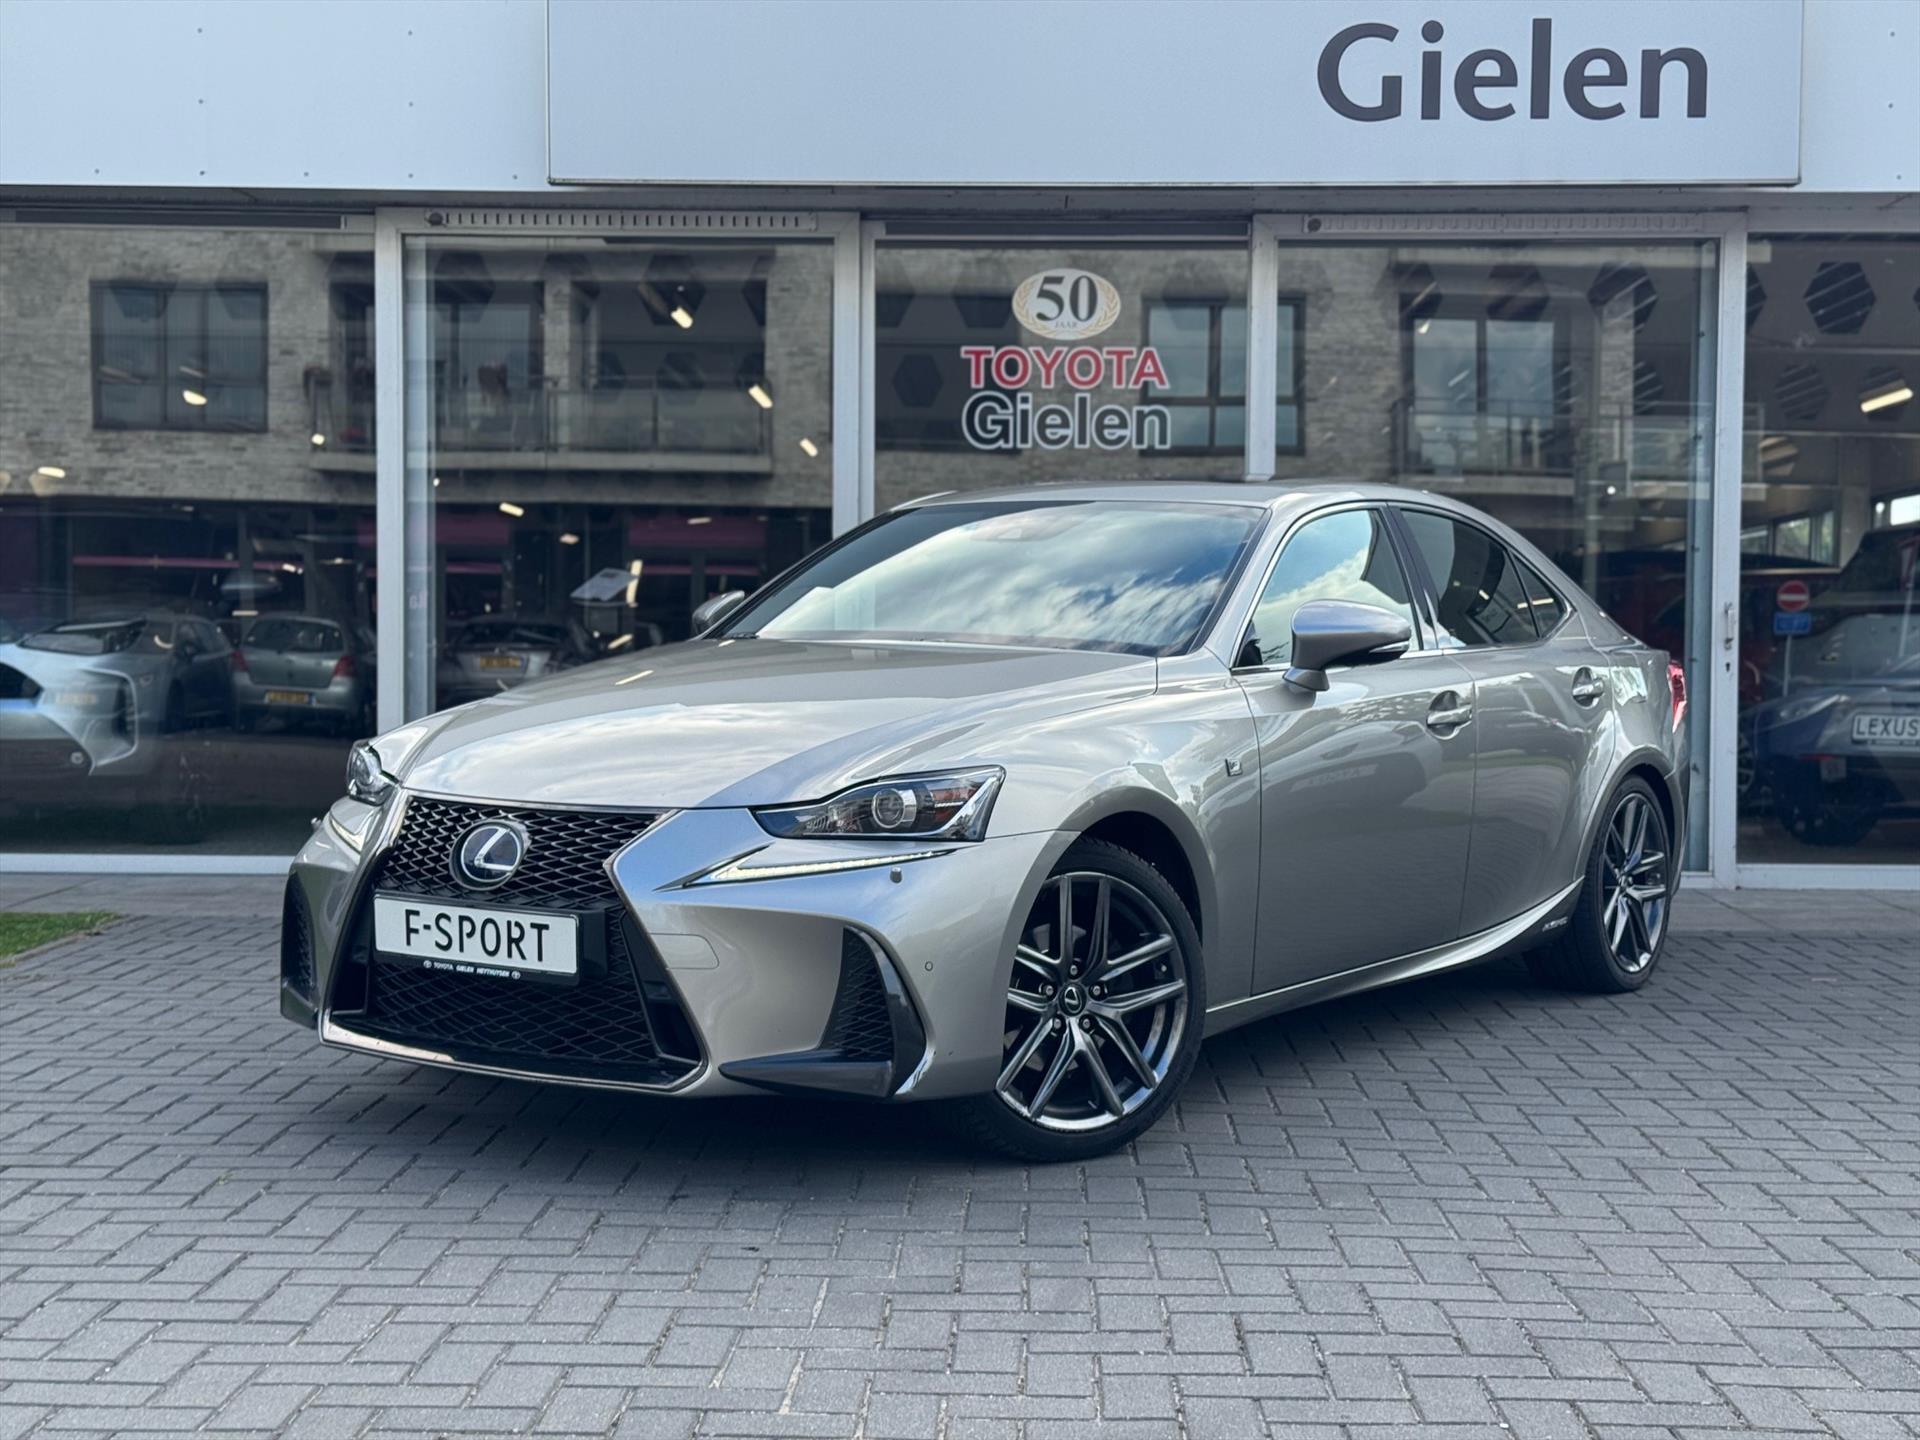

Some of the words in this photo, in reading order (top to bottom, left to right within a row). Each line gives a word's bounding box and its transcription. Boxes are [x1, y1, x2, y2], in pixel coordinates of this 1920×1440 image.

[1317, 18, 1708, 122] Gielen
[1035, 275, 1099, 322] 50
[1054, 320, 1079, 329] JAAR
[961, 346, 1170, 390] TOYOTA
[962, 390, 1172, 450] Gielen
[1855, 717, 1919, 737] LEXUS
[404, 908, 550, 962] F-SPORT
